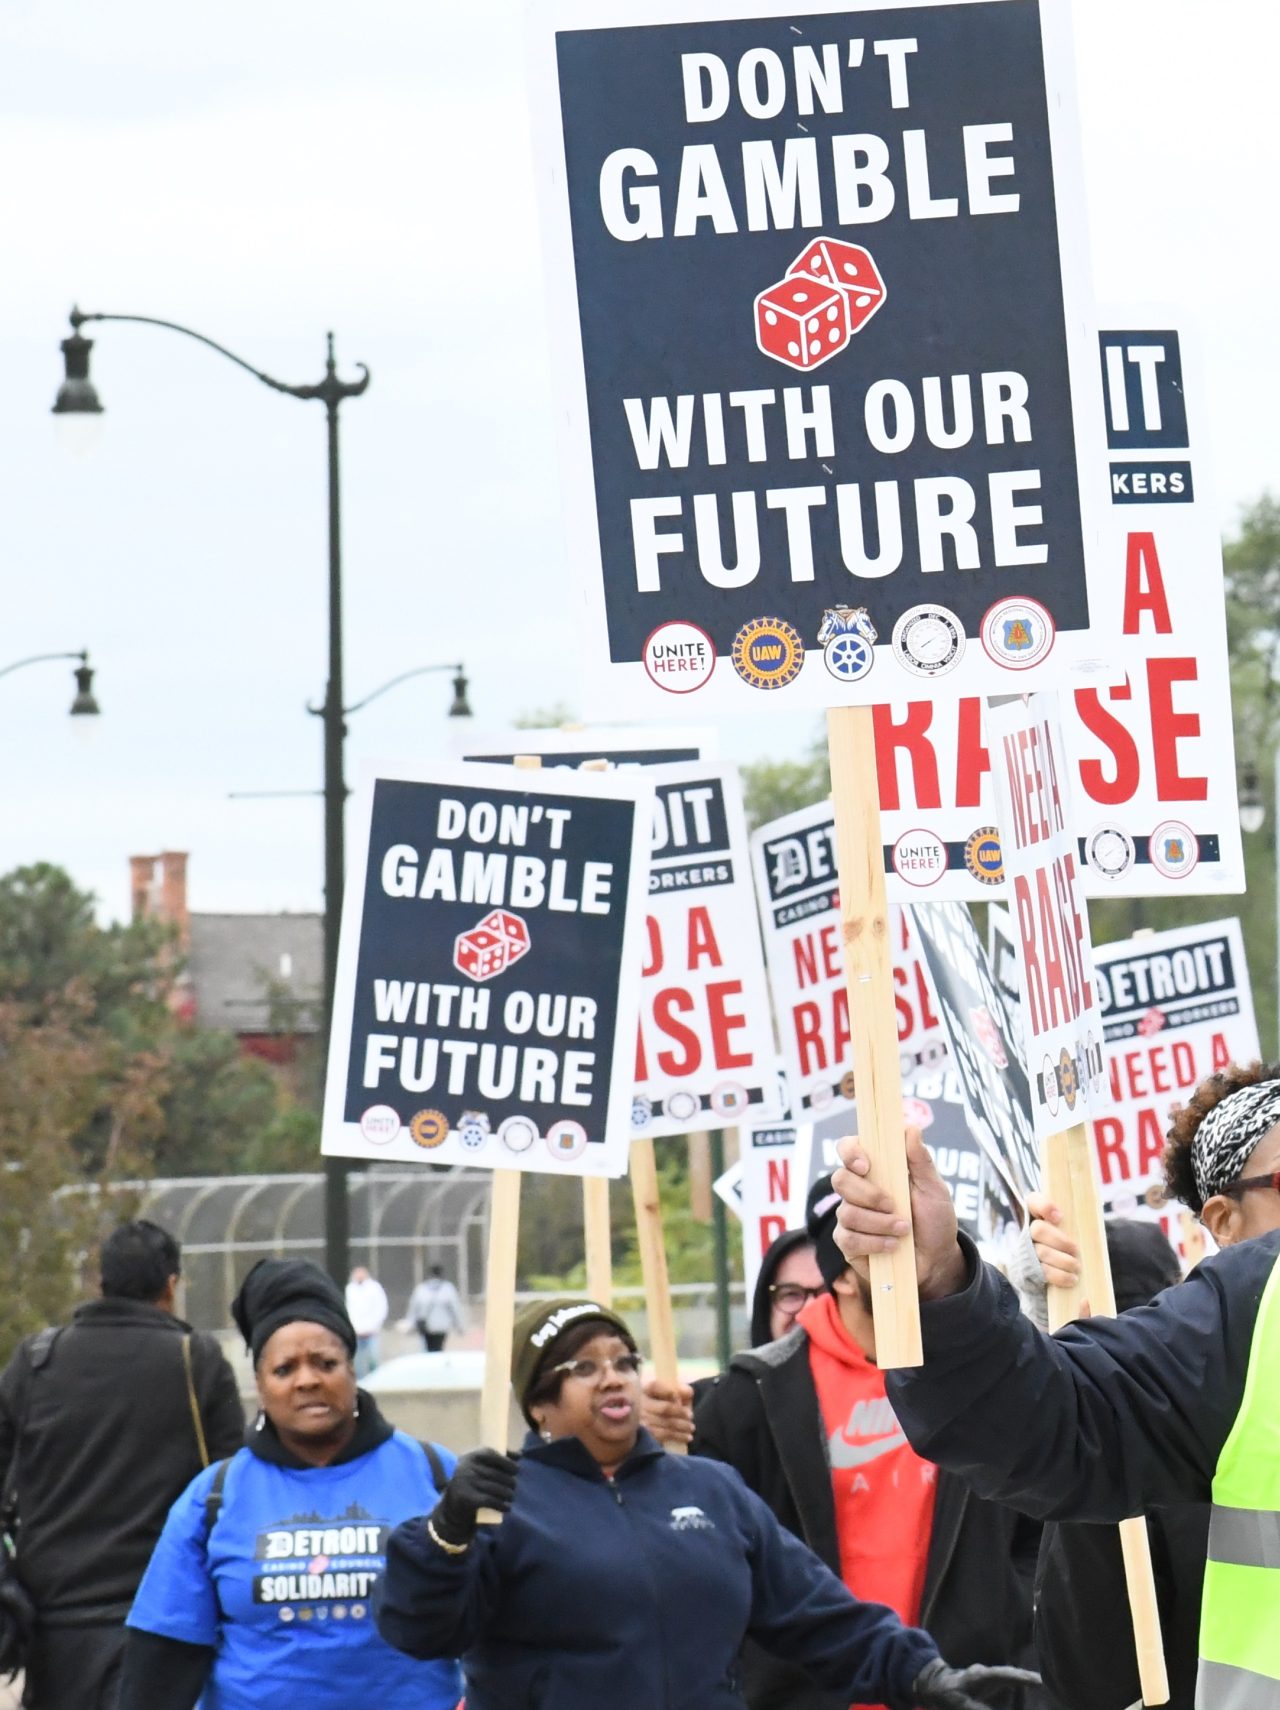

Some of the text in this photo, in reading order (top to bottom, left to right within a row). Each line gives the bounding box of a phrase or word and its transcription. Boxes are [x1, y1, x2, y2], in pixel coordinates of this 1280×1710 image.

[681, 37, 919, 124] DON'T
[598, 122, 1021, 243] GAMBLE
[623, 371, 1033, 470] WITH OUR
[630, 469, 1049, 593] FUTURE
[1122, 531, 1174, 635] A
[652, 643, 706, 660] UNITE
[653, 656, 706, 673] HERE!
[752, 644, 782, 662] UAW
[437, 799, 572, 850] DON'T
[900, 846, 940, 859] UNITE
[901, 857, 940, 870] HERE!
[381, 844, 613, 915] GAMBLE
[777, 895, 829, 924] CASINO
[687, 905, 723, 971] A
[374, 979, 598, 1040] WITH OUR
[1168, 1000, 1238, 1026] WORKERS
[363, 1033, 596, 1107] FUTURE
[1212, 1033, 1230, 1073] A
[851, 1464, 938, 1494] AIR
[266, 1526, 380, 1559] DETROIT
